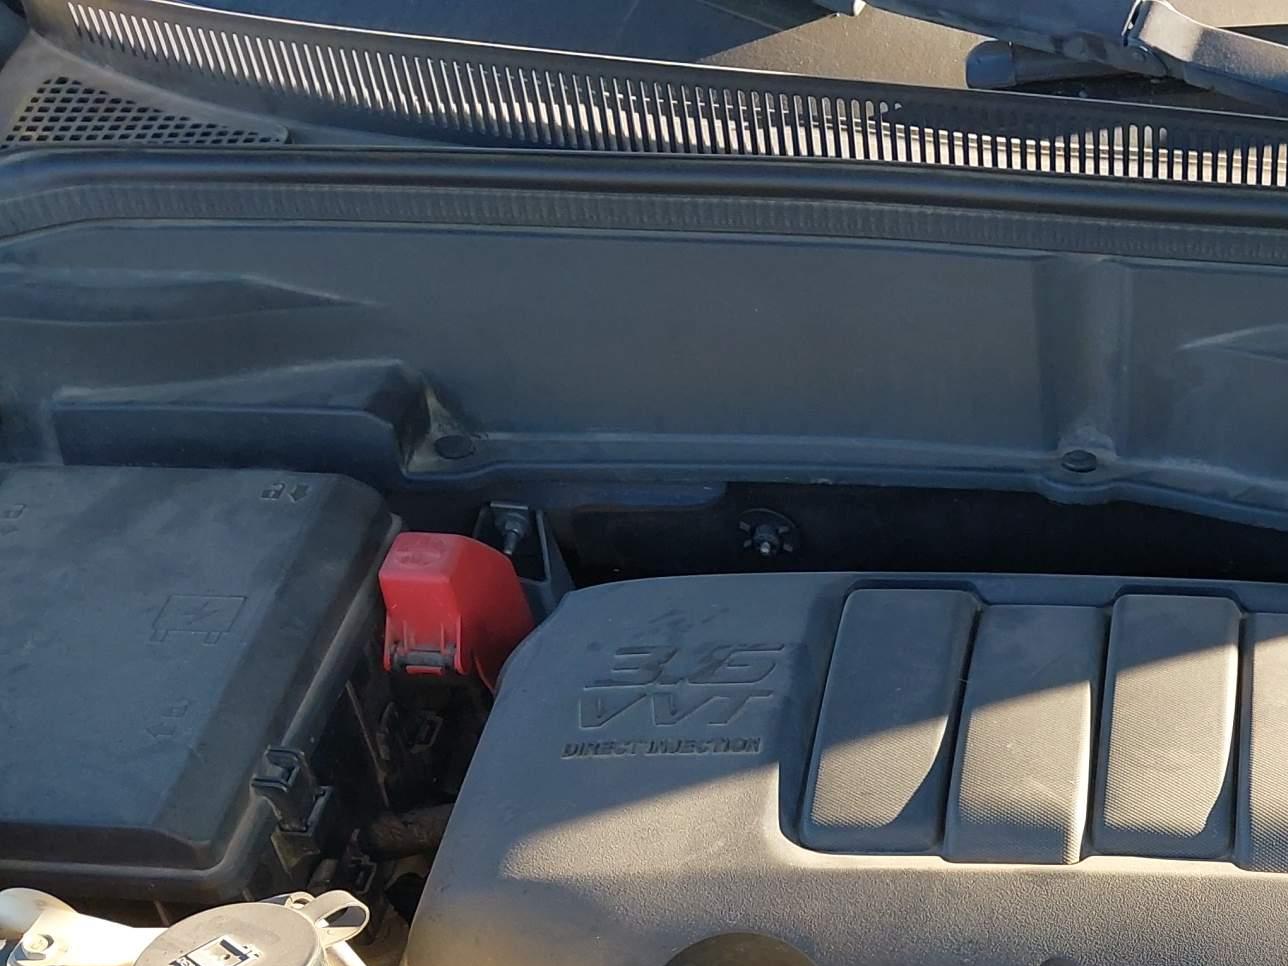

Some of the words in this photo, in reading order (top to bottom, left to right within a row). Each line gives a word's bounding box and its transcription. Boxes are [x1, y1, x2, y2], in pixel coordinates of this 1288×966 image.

[584, 643, 785, 689] 3.6
[578, 689, 775, 729] VVT
[561, 741, 643, 759] DIRECT
[645, 737, 762, 756] INJECTION
